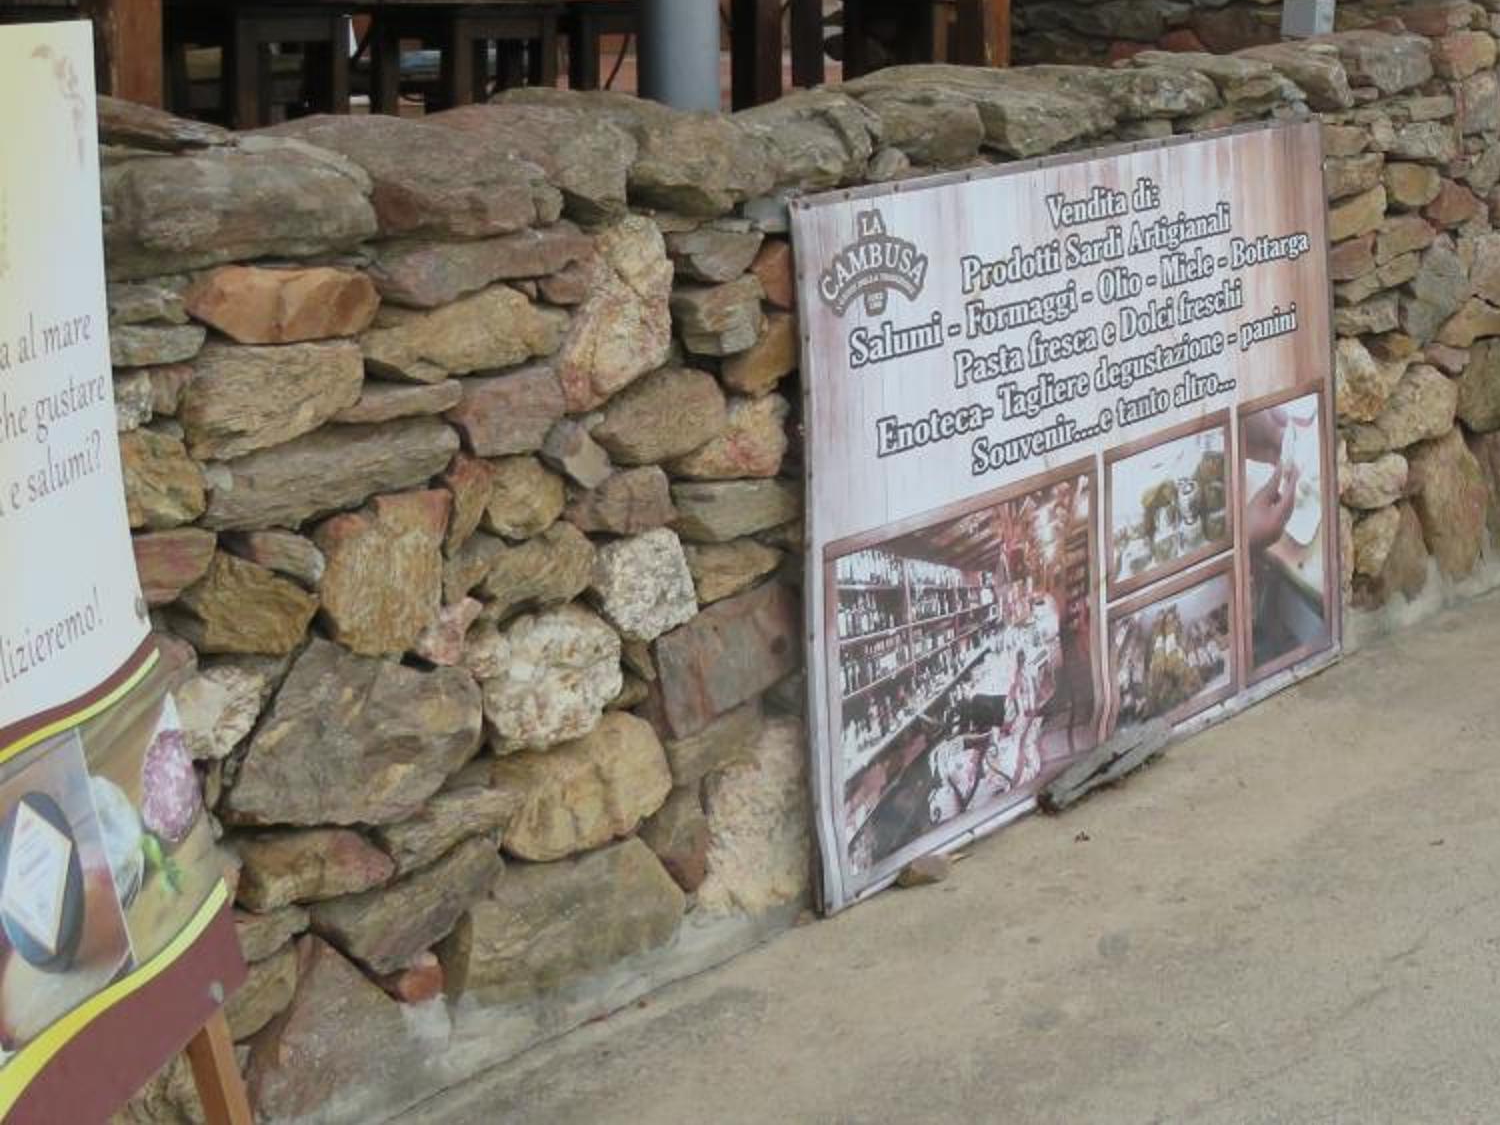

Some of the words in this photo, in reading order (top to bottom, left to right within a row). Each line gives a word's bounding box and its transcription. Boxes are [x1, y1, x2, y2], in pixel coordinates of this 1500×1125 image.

[861, 214, 884, 236] LA
[1047, 186, 1128, 229] Vendita
[1132, 177, 1160, 212] di:
[820, 242, 927, 300] CAMBUSA
[960, 239, 1062, 294] Prodotti
[1066, 226, 1124, 270] Sardi
[1128, 202, 1231, 256] Artigianali
[850, 310, 944, 369] Salumi
[966, 280, 1078, 339] Formaggi
[1097, 264, 1142, 305] Olio
[1160, 247, 1214, 289] Miele
[1230, 231, 1310, 270] Bottarga
[954, 344, 1025, 389] Pasta
[1028, 327, 1098, 368] fresca
[1102, 321, 1116, 346] e
[1119, 296, 1175, 342] Dolci
[1175, 278, 1243, 325] freschi
[19, 312, 36, 364] al
[43, 315, 91, 354] mare
[0, 392, 28, 441] he
[35, 375, 105, 444] gustare
[876, 404, 994, 458] Enoteca-
[998, 372, 1091, 421] Tagliere
[1094, 331, 1224, 392] degustazione
[1240, 302, 1298, 351] panini
[1116, 387, 1171, 427] tanto
[1173, 369, 1237, 408] altro...
[11, 482, 20, 510] e
[28, 428, 101, 502] salumi?
